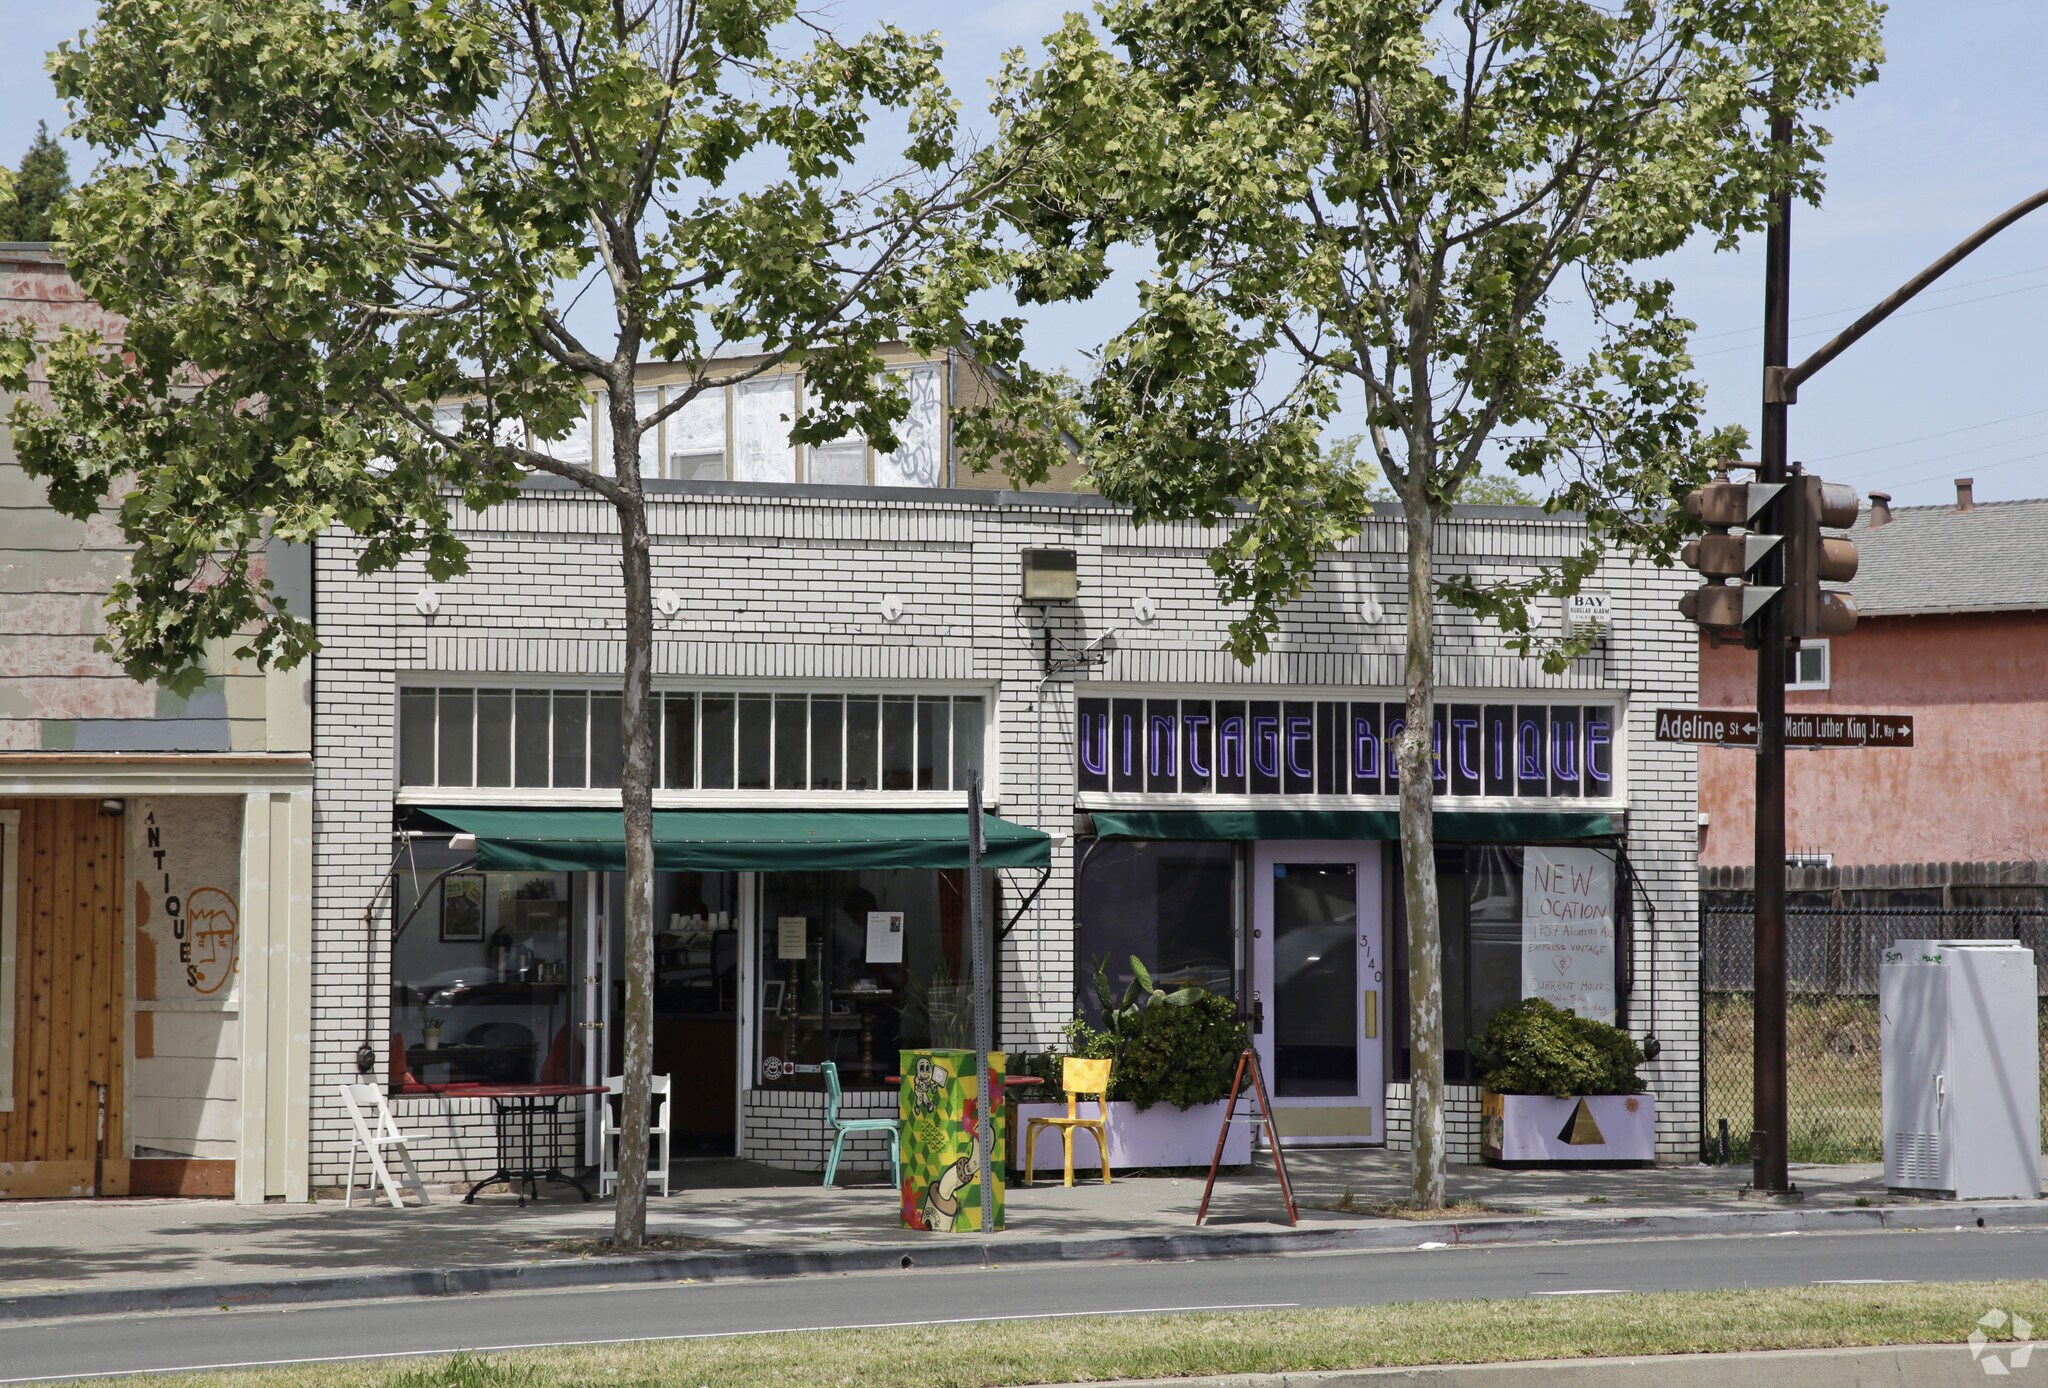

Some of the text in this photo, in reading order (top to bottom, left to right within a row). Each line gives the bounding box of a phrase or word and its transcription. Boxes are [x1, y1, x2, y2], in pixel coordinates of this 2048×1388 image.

[1574, 596, 1606, 607] BAY
[1658, 713, 1740, 740] Adeline St
[1784, 716, 1895, 744] Martin Luther King Jr. Way
[1081, 713, 1313, 778] VINTAGE
[1534, 863, 1594, 897] NEW
[1533, 923, 1560, 939] 1757
[1360, 935, 1382, 983] 3140
[1528, 943, 1607, 956] EMPRESS VINTAGE
[1529, 978, 1611, 993] CURRENT HOURS
